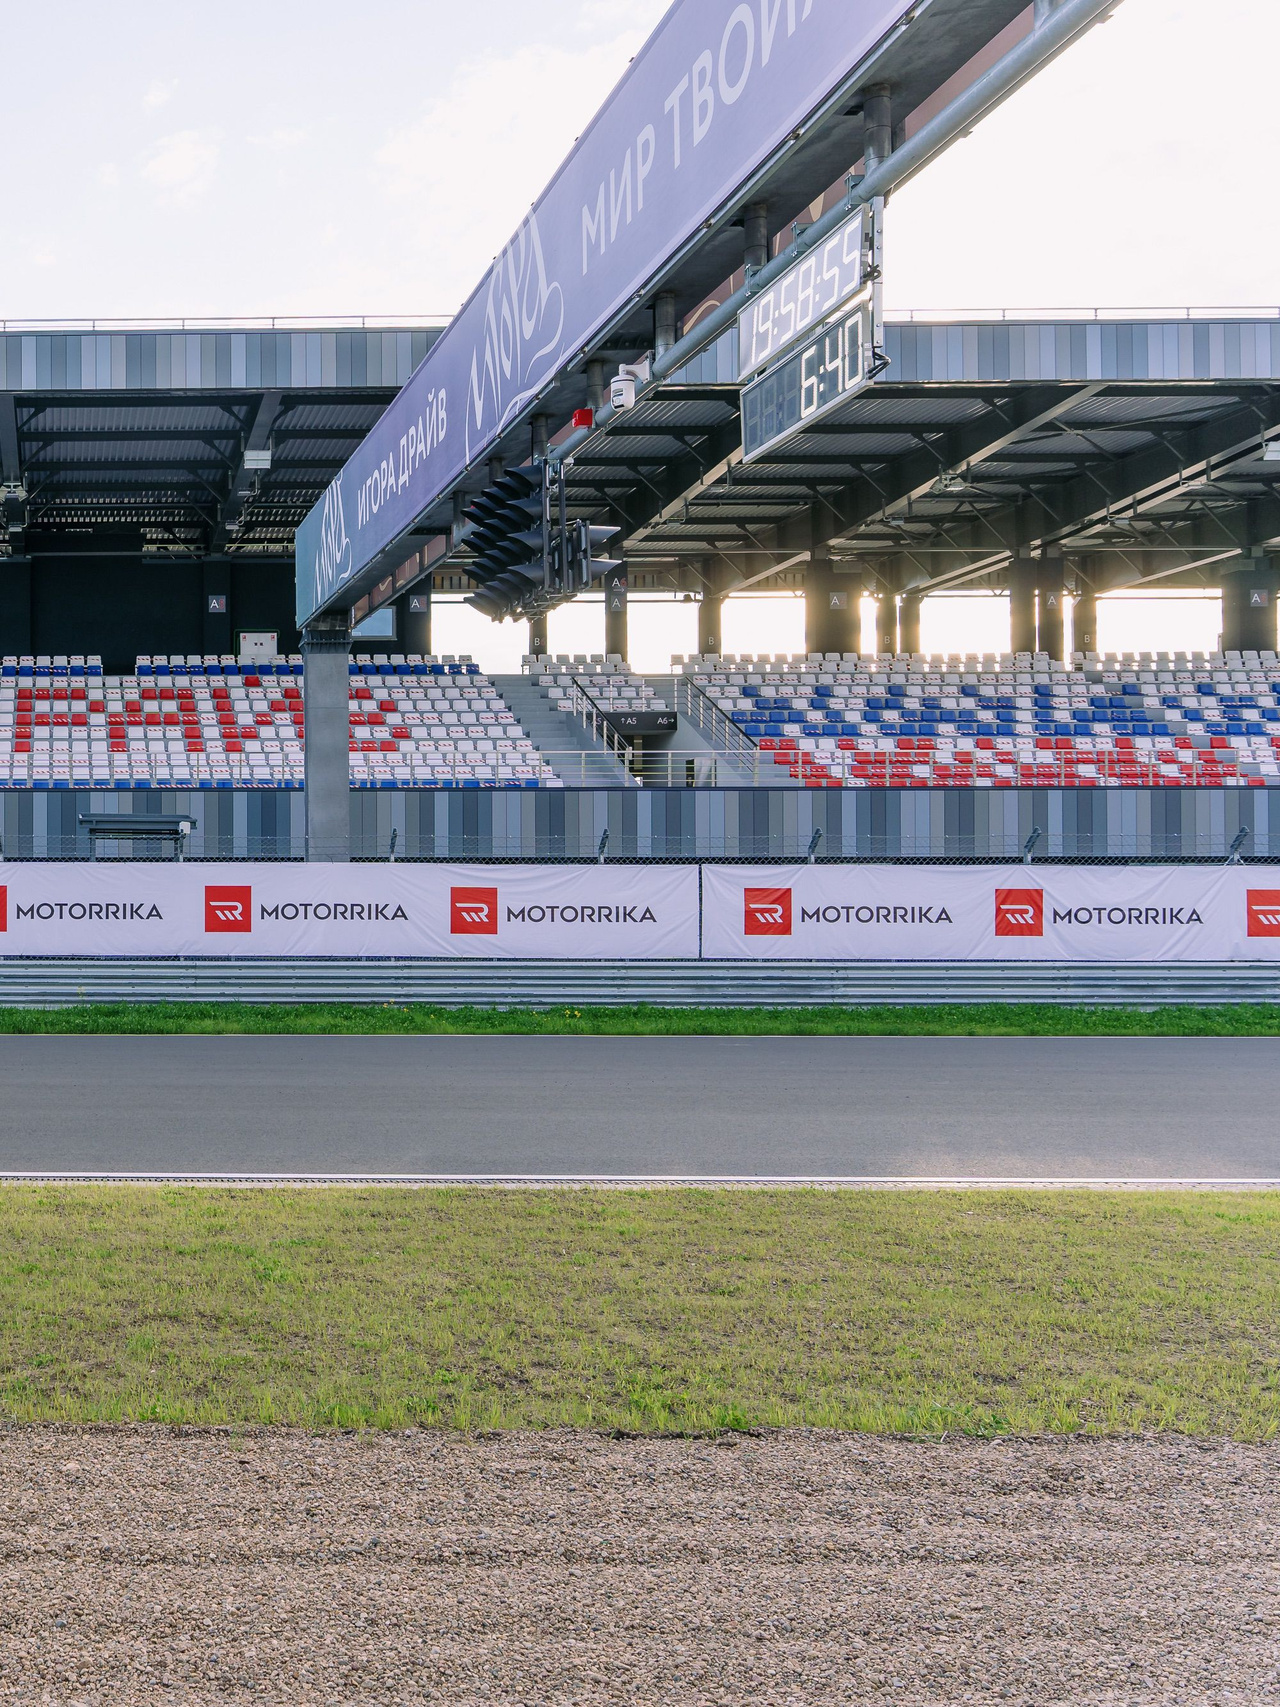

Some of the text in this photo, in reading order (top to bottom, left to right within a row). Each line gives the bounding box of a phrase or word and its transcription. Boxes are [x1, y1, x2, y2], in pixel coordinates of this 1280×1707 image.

[581, 0, 812, 276] МИР ТВОИ
[751, 217, 861, 365] 19:58:55
[800, 311, 862, 420] 6:40
[357, 387, 447, 531] ИГОРА ДРАЙВ
[16, 902, 164, 920] MOTORRIKA
[260, 902, 409, 921] MOTORRIKA
[506, 905, 658, 923] MOTORRIKA
[801, 905, 954, 924] MOTORRIKA
[1052, 907, 1204, 925] MOTORRIKA
